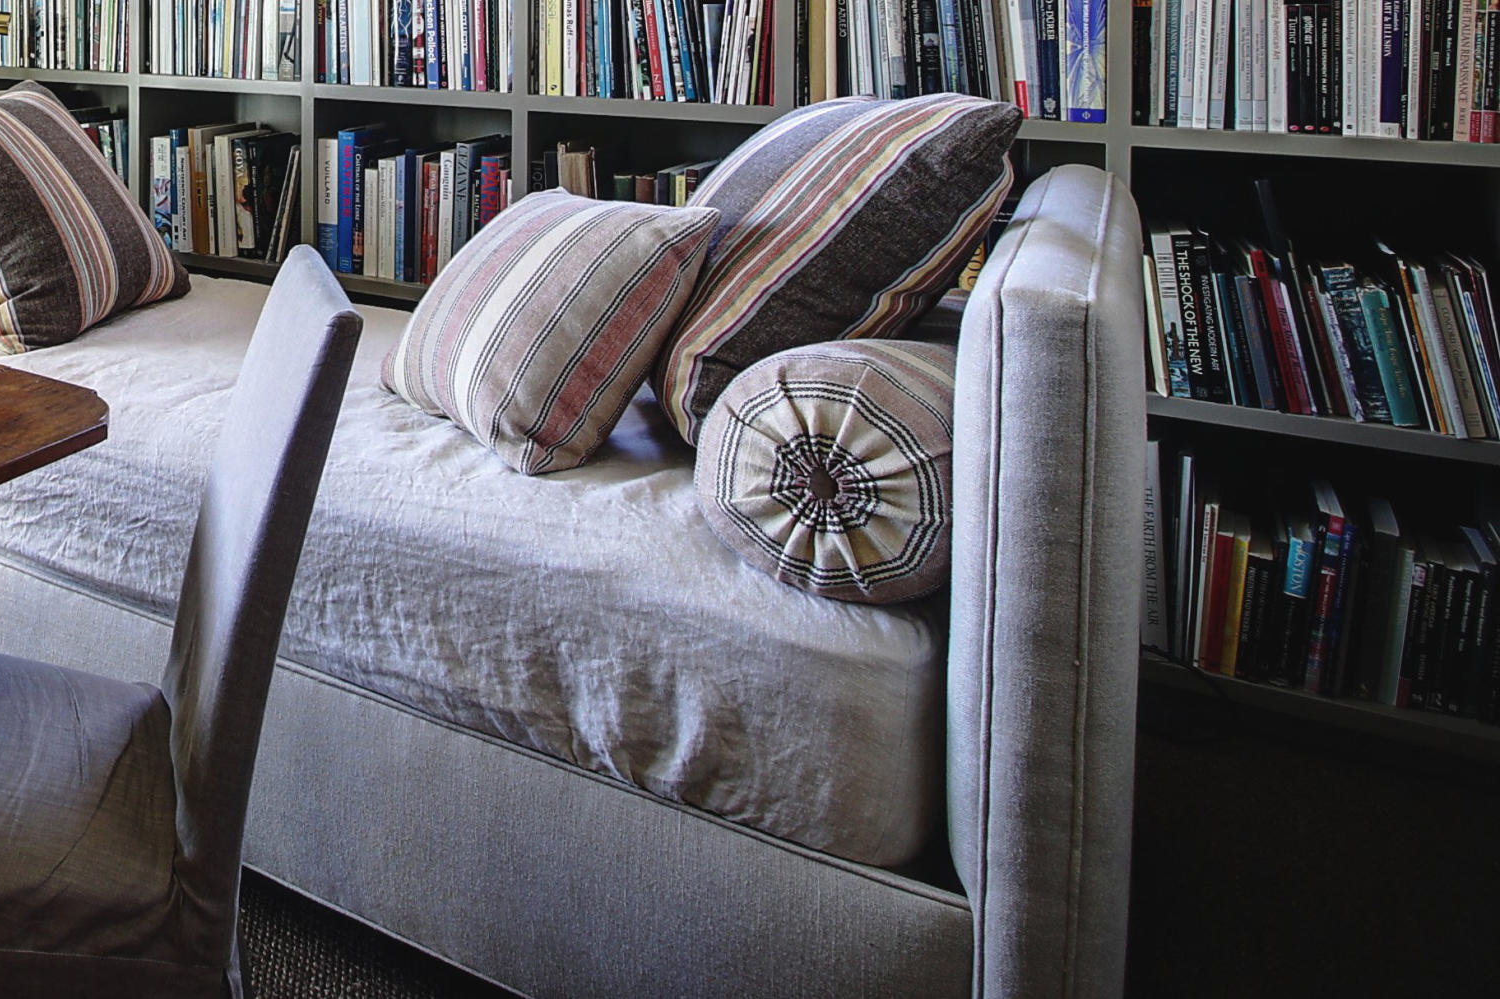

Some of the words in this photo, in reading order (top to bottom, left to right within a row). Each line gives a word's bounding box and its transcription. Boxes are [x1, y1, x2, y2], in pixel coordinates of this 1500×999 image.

[1383, 0, 1392, 15] ART
[1462, 0, 1472, 15] THE
[339, 19, 348, 54] ARTISTS
[566, 19, 575, 36] Ruff
[1272, 20, 1280, 50] American
[1383, 23, 1392, 57] ILLUSION
[426, 30, 437, 64] Pollock
[1272, 50, 1280, 60] Art
[234, 147, 244, 178] GOYA
[442, 159, 452, 201] Gauguin
[481, 162, 499, 225] PARIS
[1175, 250, 1190, 271] THE
[1179, 272, 1194, 309] SHOCK
[1183, 310, 1195, 326] OF
[1185, 326, 1198, 347] THE
[1189, 348, 1203, 375] NEW
[1145, 549, 1157, 581] FROM
[1146, 583, 1158, 606] THE
[1147, 608, 1159, 626] AIR
